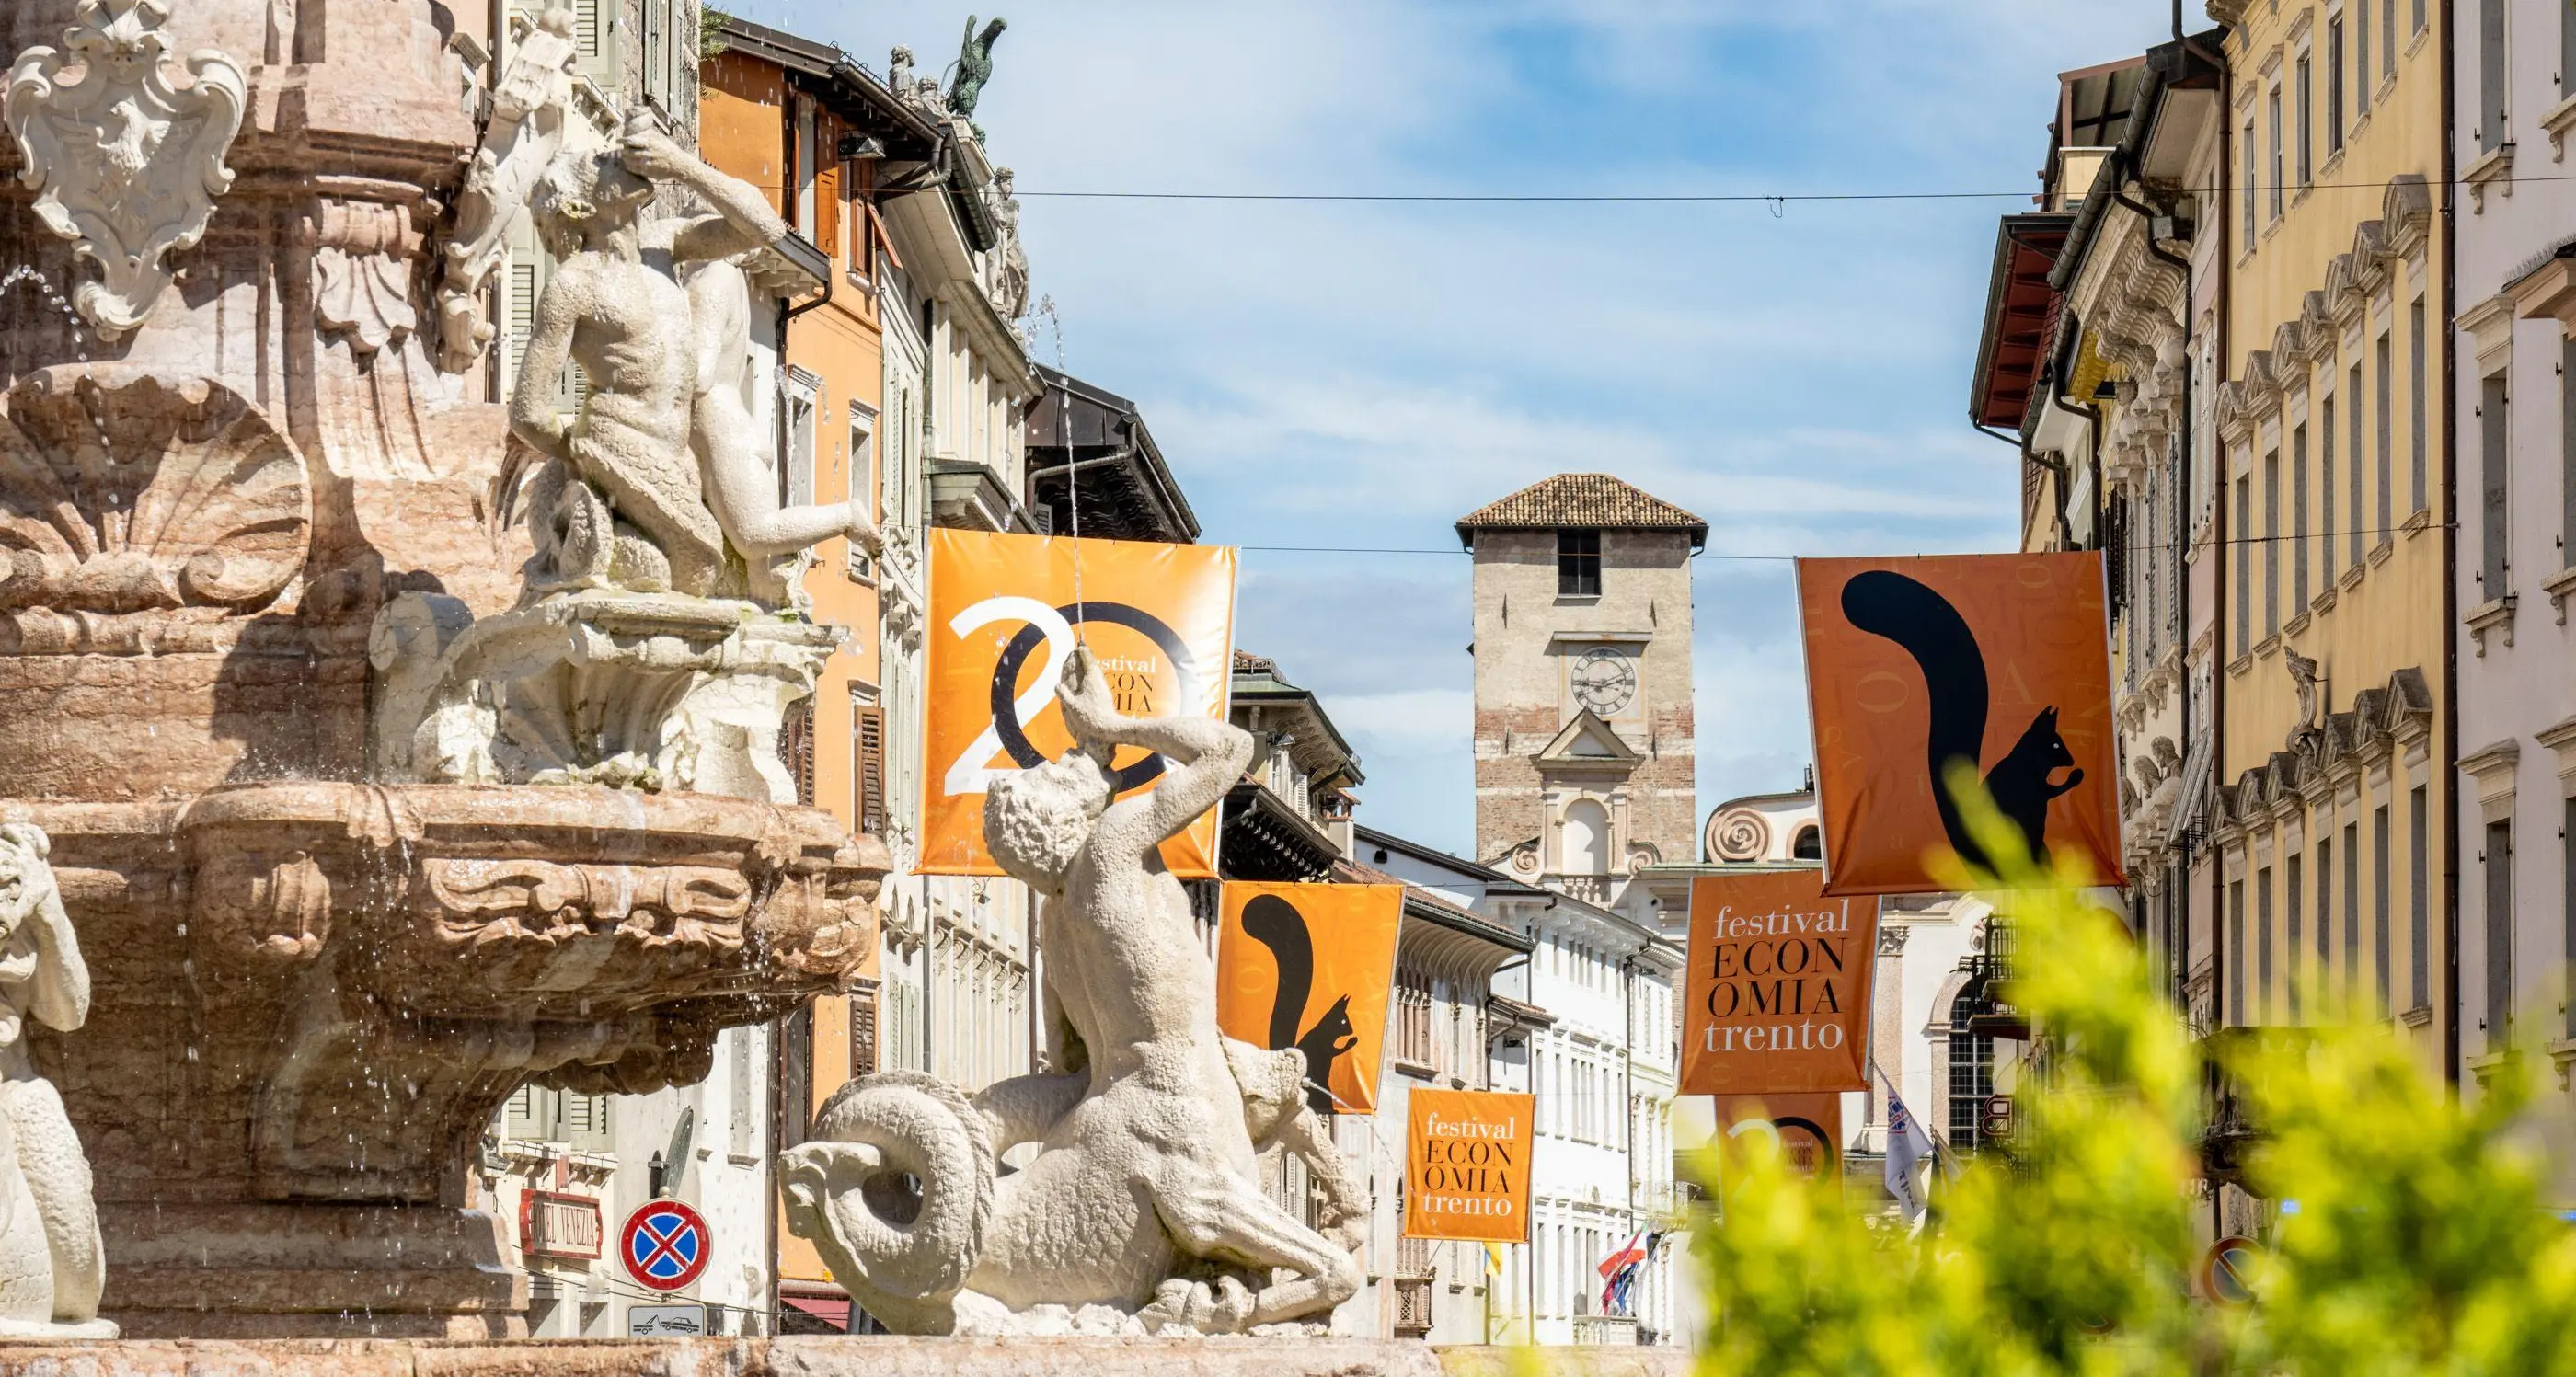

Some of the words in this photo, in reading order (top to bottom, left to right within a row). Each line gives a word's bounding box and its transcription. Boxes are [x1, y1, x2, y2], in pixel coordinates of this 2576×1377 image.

[1094, 654, 1157, 673] stival
[1103, 671, 1154, 693] CON
[1713, 897, 1851, 940] festival
[1709, 937, 1848, 980] ECON
[1708, 978, 1844, 1018] OMIA
[1703, 1016, 1843, 1052] trento
[1427, 1111, 1516, 1140] festival
[1426, 1139, 1514, 1167] ECON
[1424, 1165, 1511, 1194] OMIA
[1422, 1192, 1512, 1217] trento
[560, 1206, 595, 1247] VENEZIA
